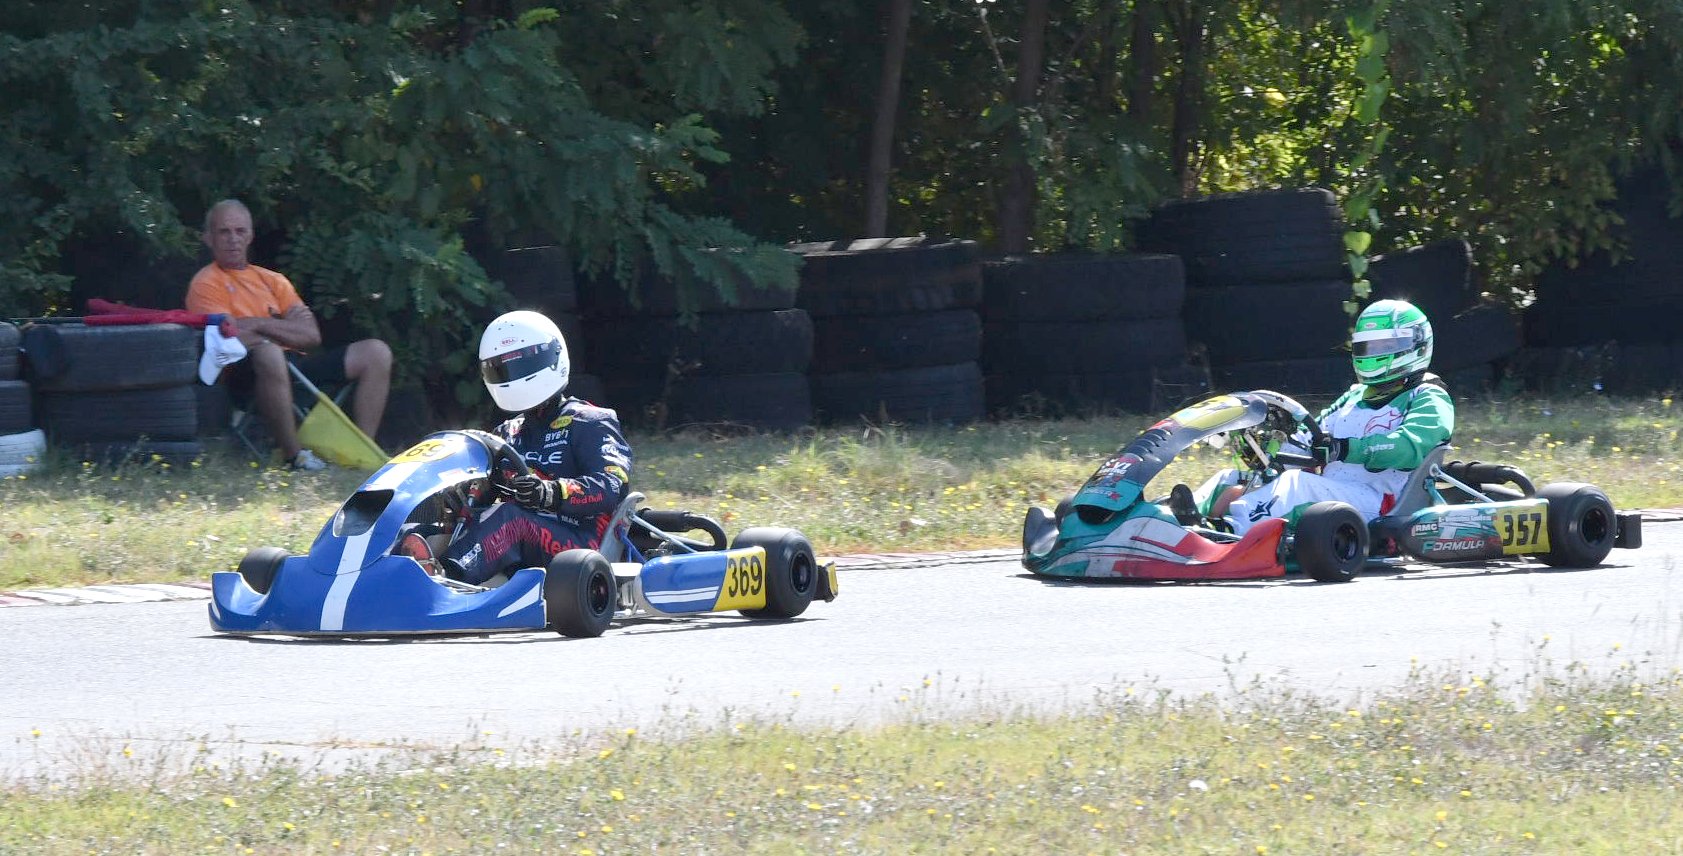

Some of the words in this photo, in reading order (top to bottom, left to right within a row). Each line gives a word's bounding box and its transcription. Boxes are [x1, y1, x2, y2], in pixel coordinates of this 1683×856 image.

[525, 451, 562, 465] CLE
[1415, 523, 1438, 533] RMC
[1502, 513, 1542, 547] 357
[1422, 539, 1486, 555] FORMULA
[728, 555, 763, 598] 369
